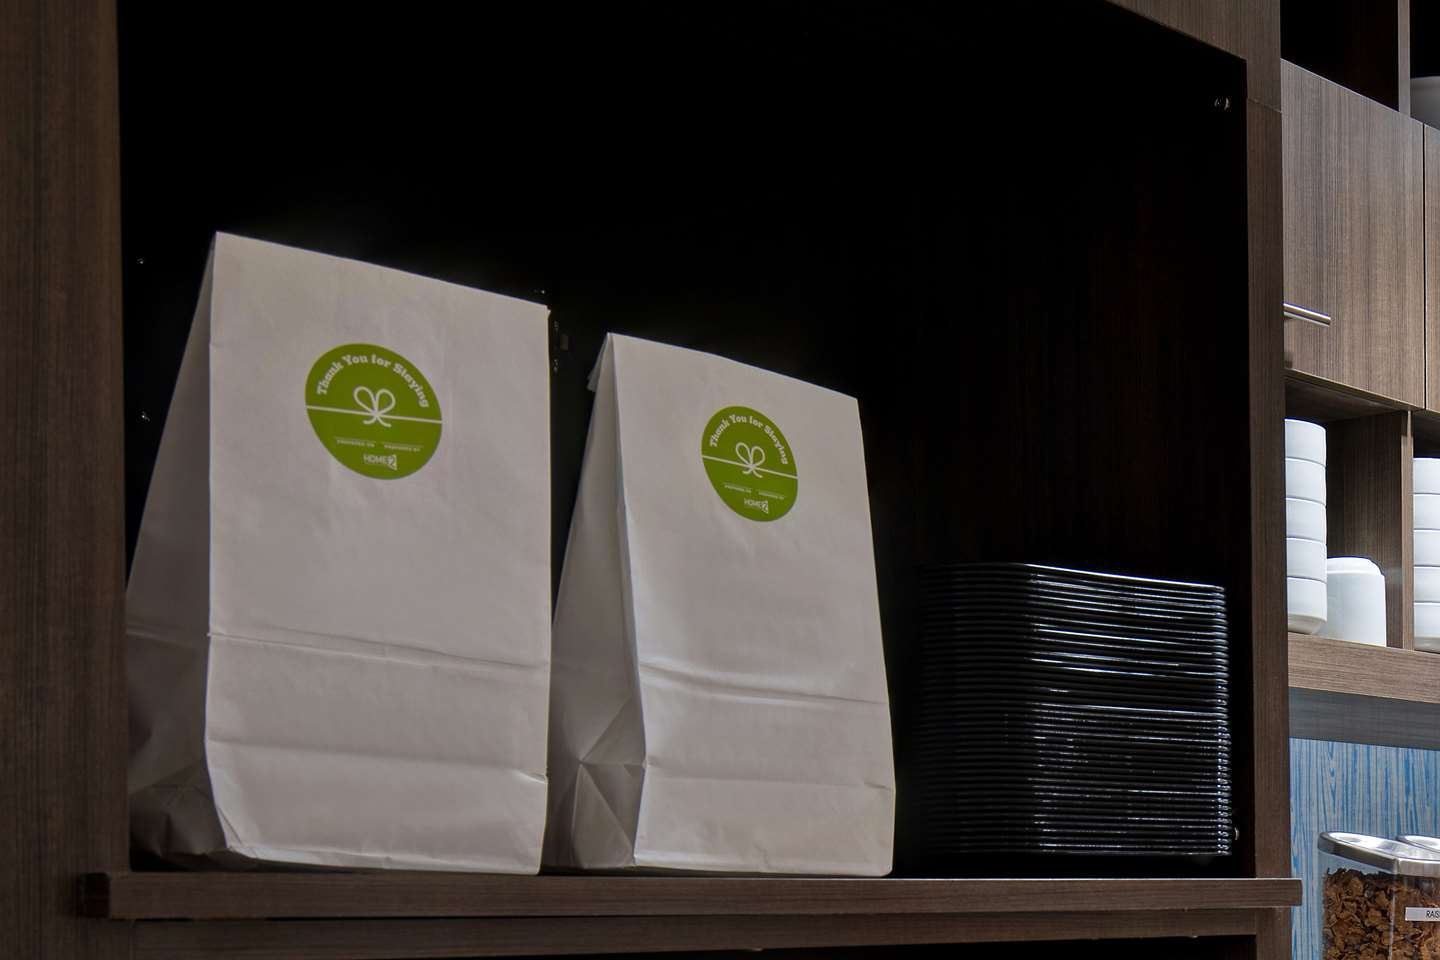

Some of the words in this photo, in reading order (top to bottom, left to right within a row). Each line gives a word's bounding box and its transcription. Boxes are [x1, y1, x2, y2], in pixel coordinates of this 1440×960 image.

[316, 361, 344, 396] Thank
[342, 353, 368, 366] You
[371, 353, 393, 369] for
[393, 362, 430, 409] Staying
[709, 418, 731, 447] Thank
[729, 413, 747, 424] You
[749, 415, 765, 428] for
[764, 425, 789, 465] Staying
